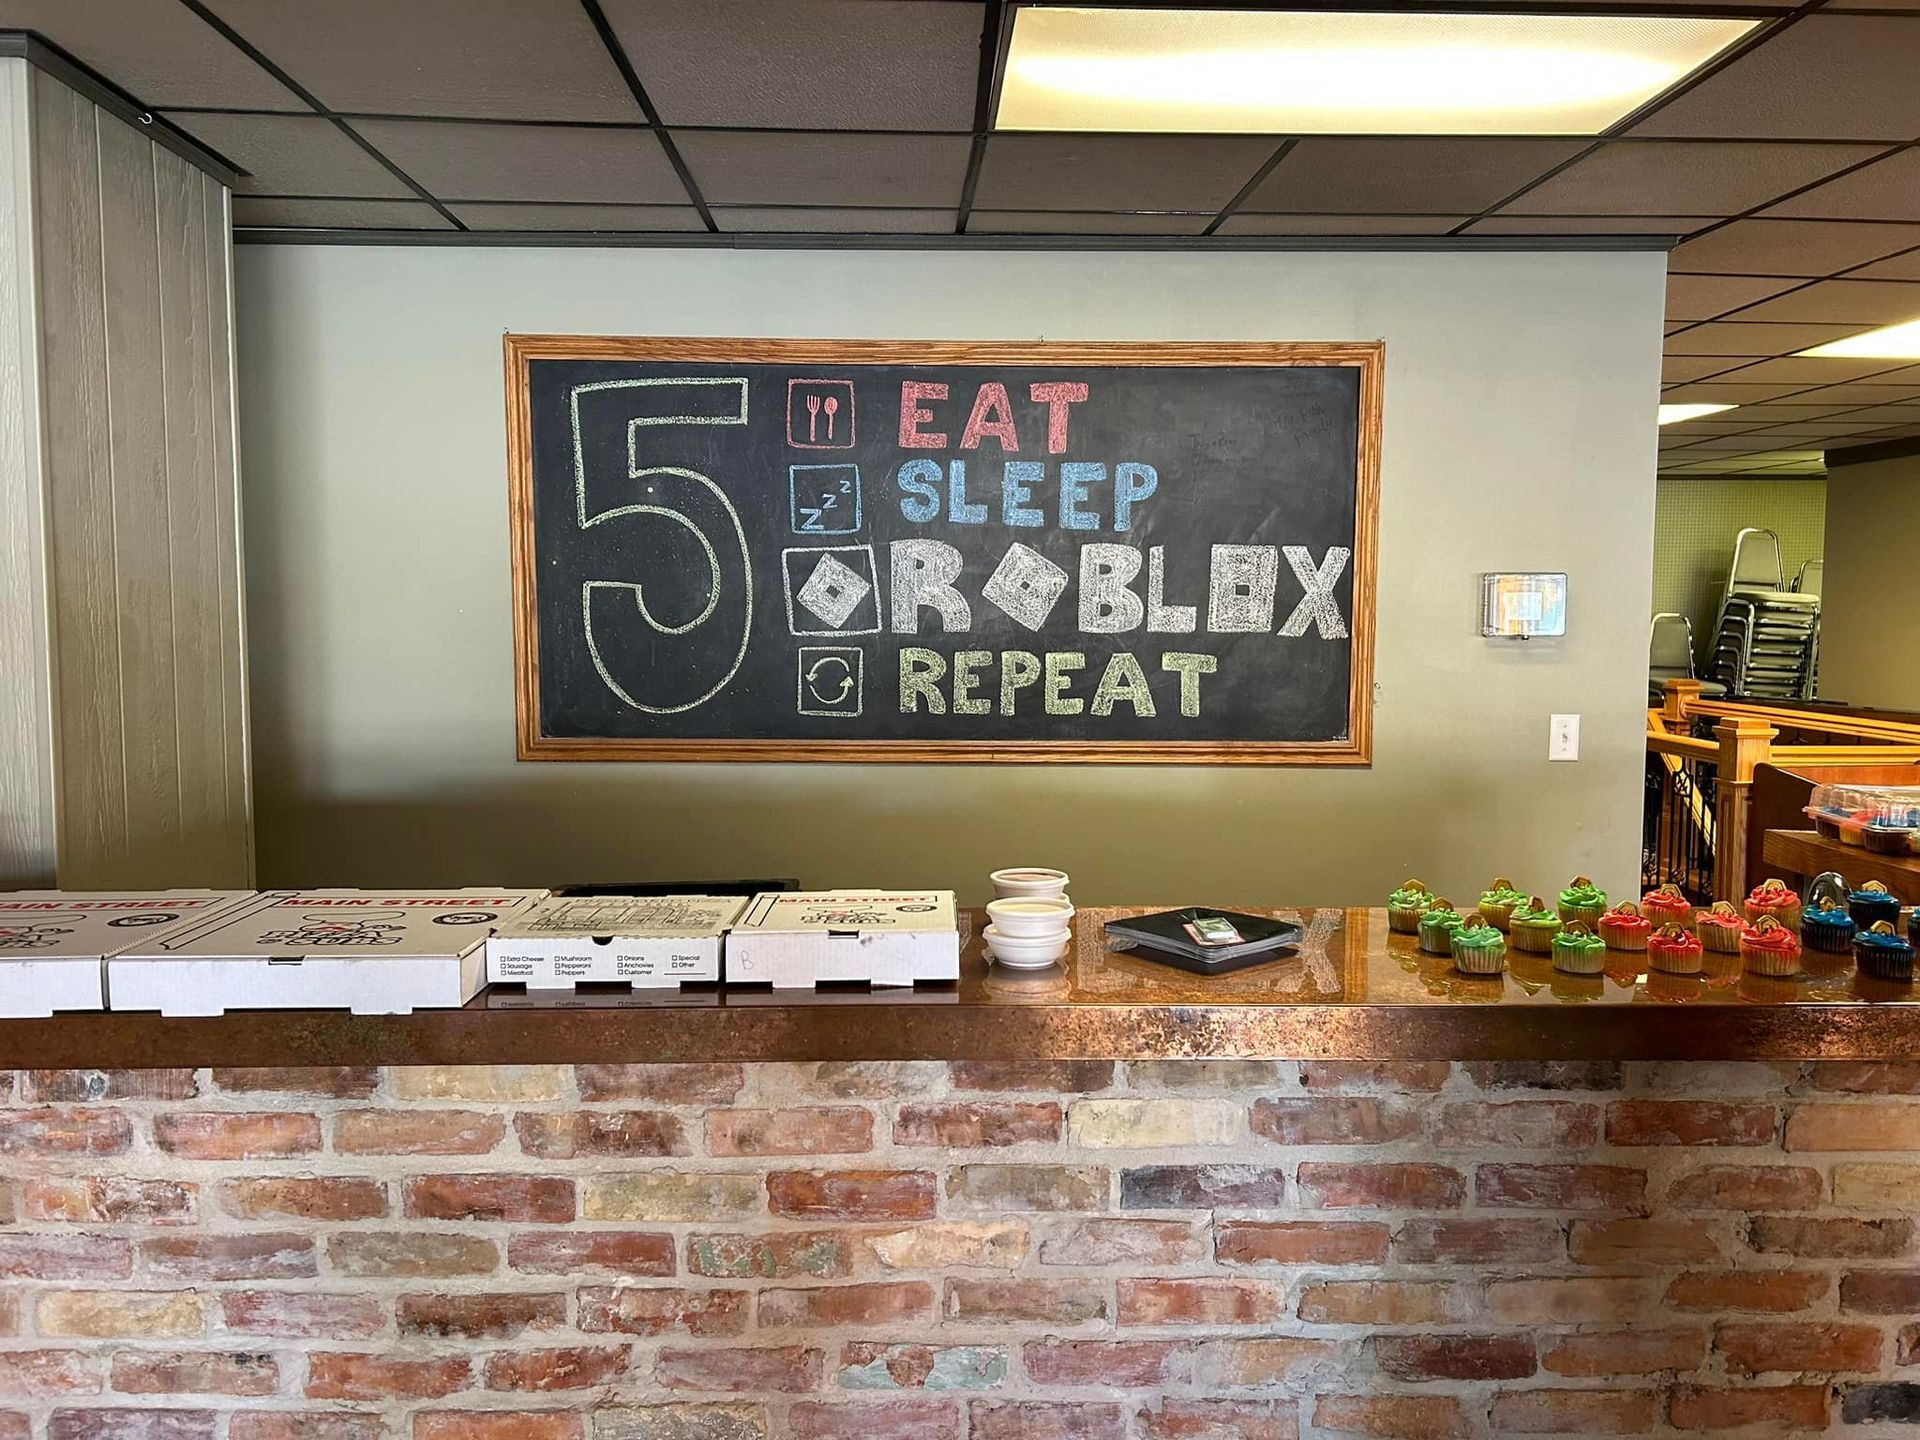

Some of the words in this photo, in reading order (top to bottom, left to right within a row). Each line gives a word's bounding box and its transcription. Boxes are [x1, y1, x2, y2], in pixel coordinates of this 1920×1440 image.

[898, 381, 1090, 454] EAT
[898, 459, 1158, 532] SLEEP
[570, 376, 754, 715] 5
[898, 647, 1219, 719] REPEAT
[0, 902, 63, 910] AIN
[69, 901, 206, 909] STREET
